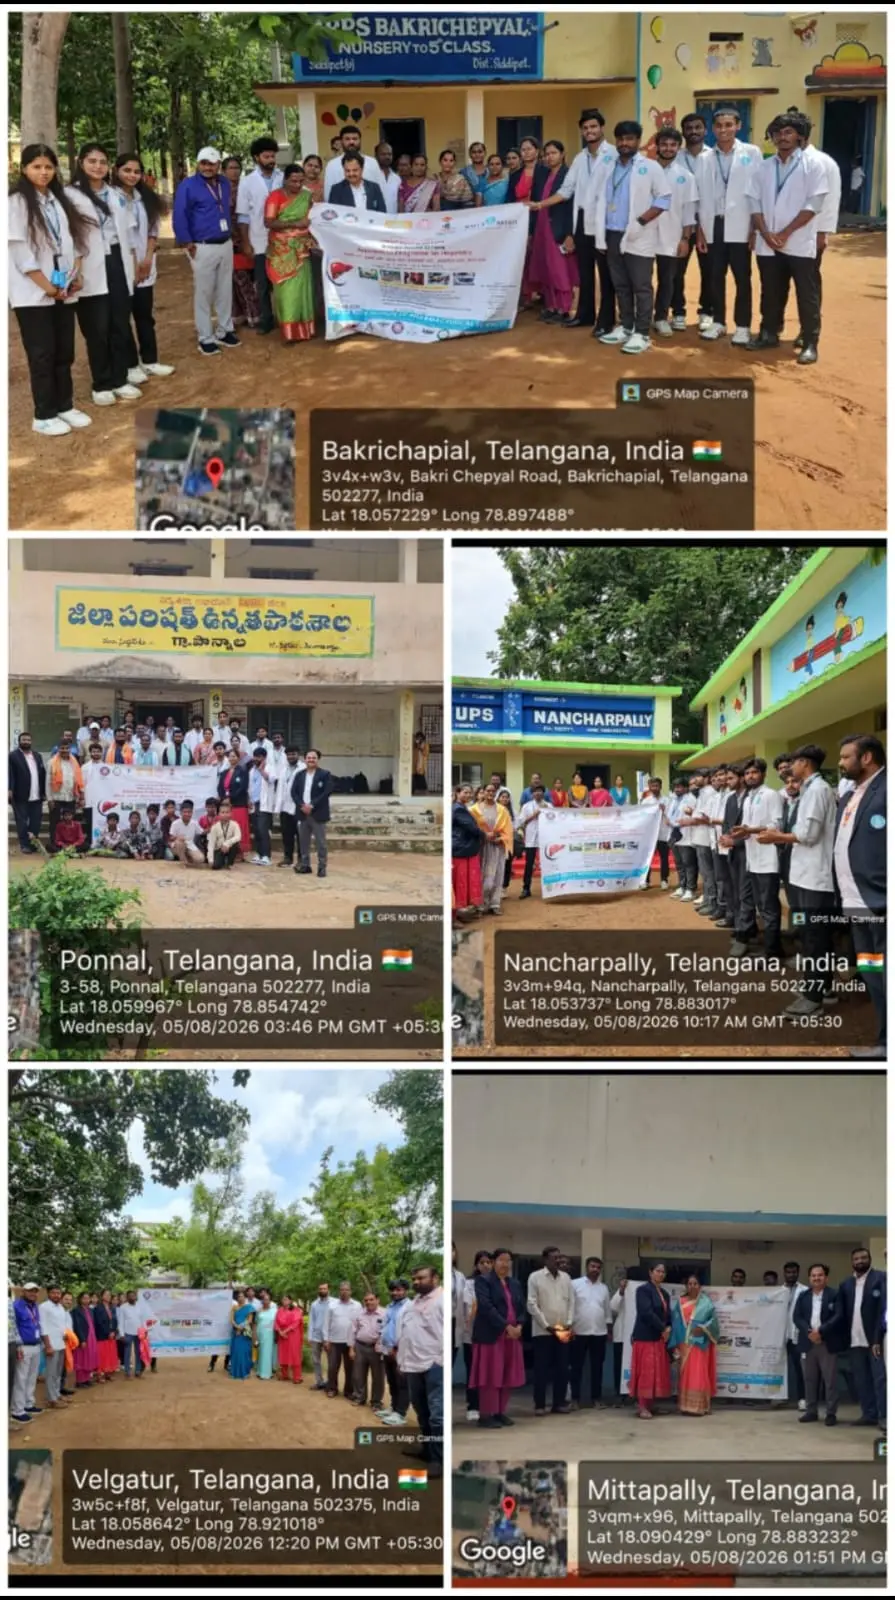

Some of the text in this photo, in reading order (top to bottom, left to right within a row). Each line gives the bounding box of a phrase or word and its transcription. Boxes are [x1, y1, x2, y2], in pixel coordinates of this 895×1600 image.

[338, 40, 411, 55] NURSERY
[455, 706, 494, 722] UPS
[533, 709, 653, 729] NANCHARPALLY
